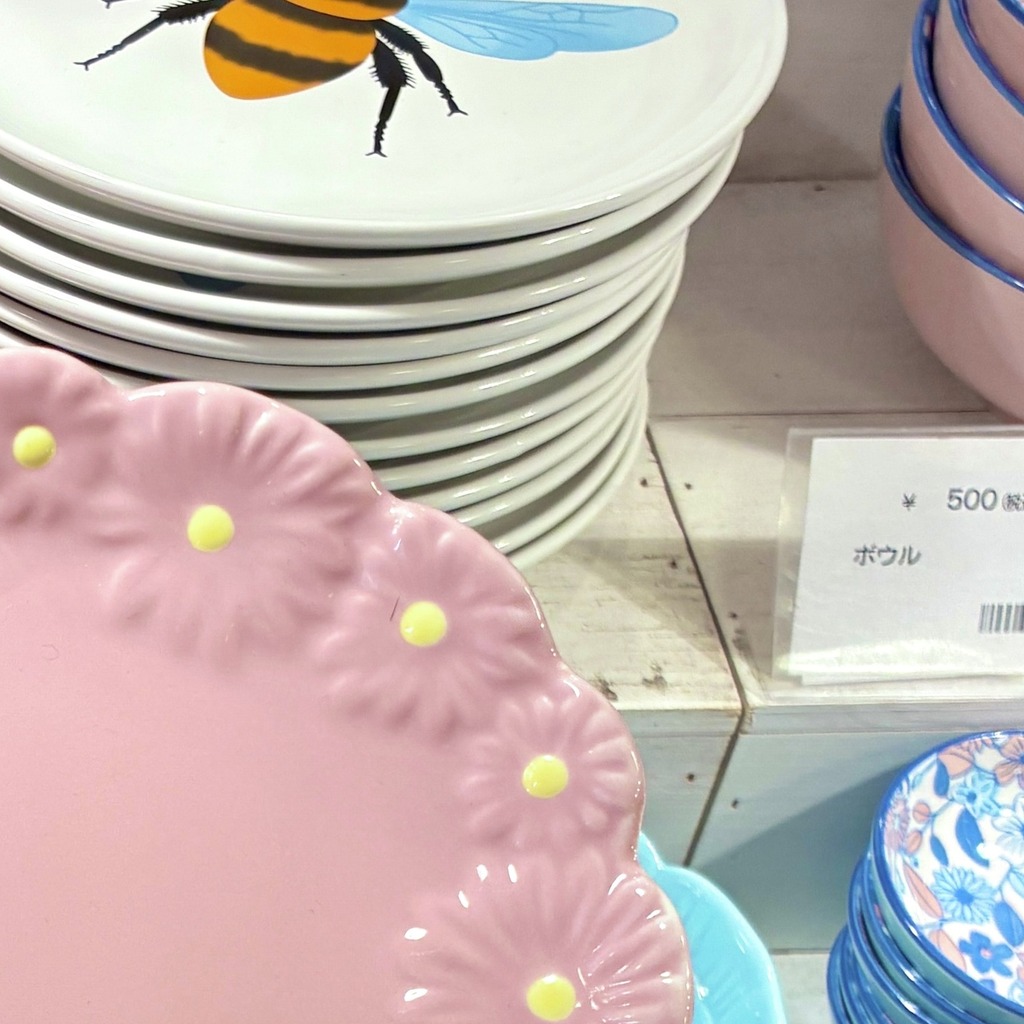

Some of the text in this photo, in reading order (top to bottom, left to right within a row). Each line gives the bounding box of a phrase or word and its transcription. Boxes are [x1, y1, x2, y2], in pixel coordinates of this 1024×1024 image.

[902, 493, 916, 511] ¥
[947, 488, 998, 511] 500
[853, 544, 922, 567] ボウル
